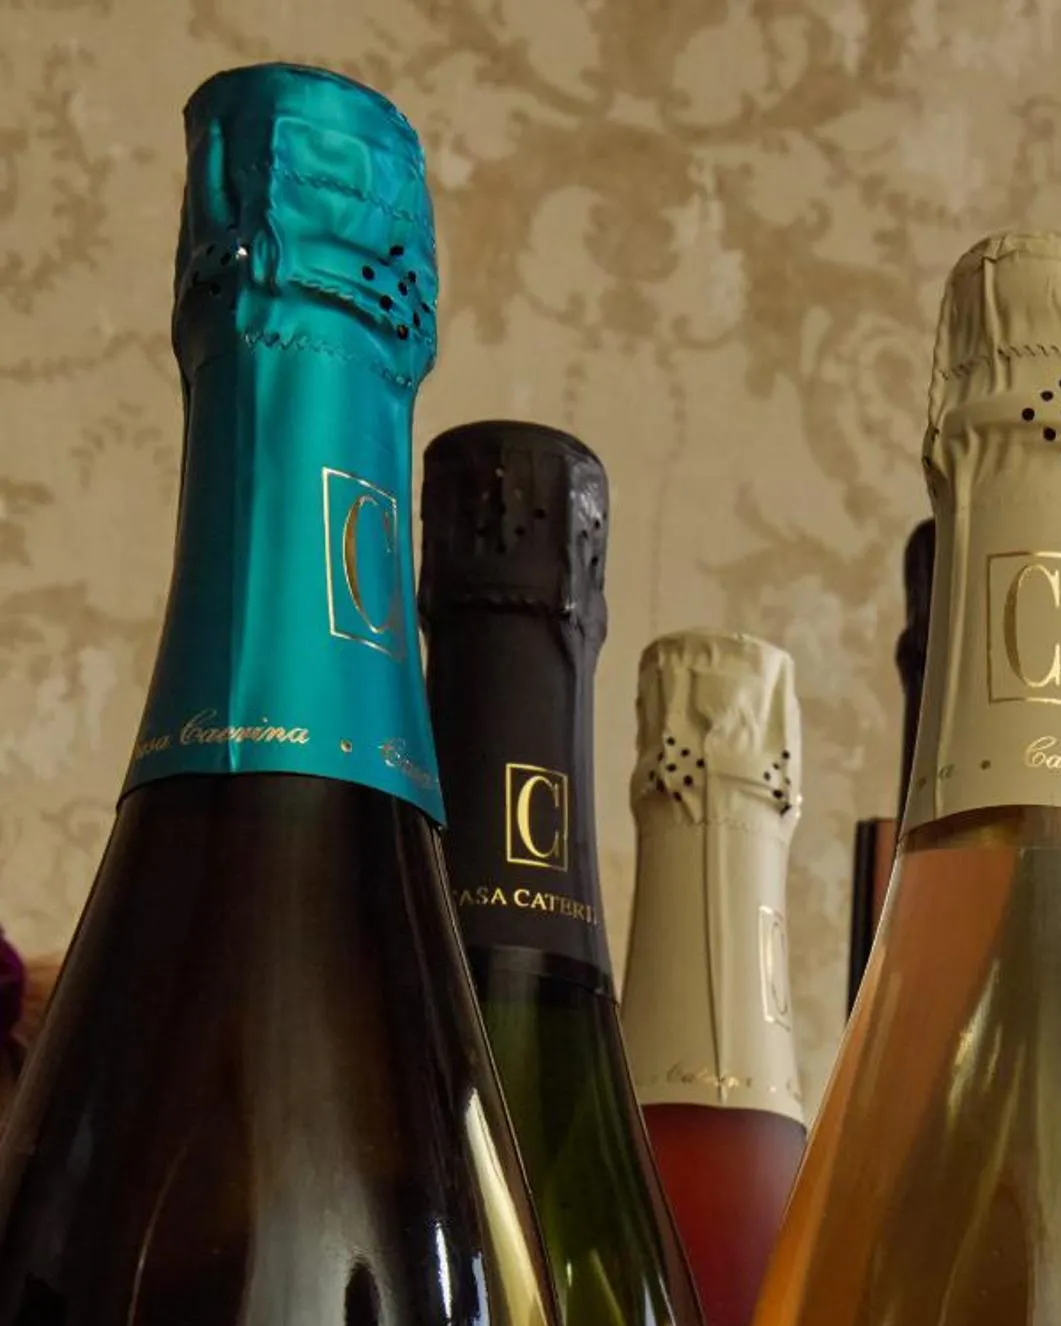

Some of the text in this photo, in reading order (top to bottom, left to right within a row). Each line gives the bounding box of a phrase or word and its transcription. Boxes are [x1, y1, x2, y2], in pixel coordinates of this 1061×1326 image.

[1003, 563, 1060, 688] C
[517, 775, 559, 857] C
[459, 887, 507, 906] ASA
